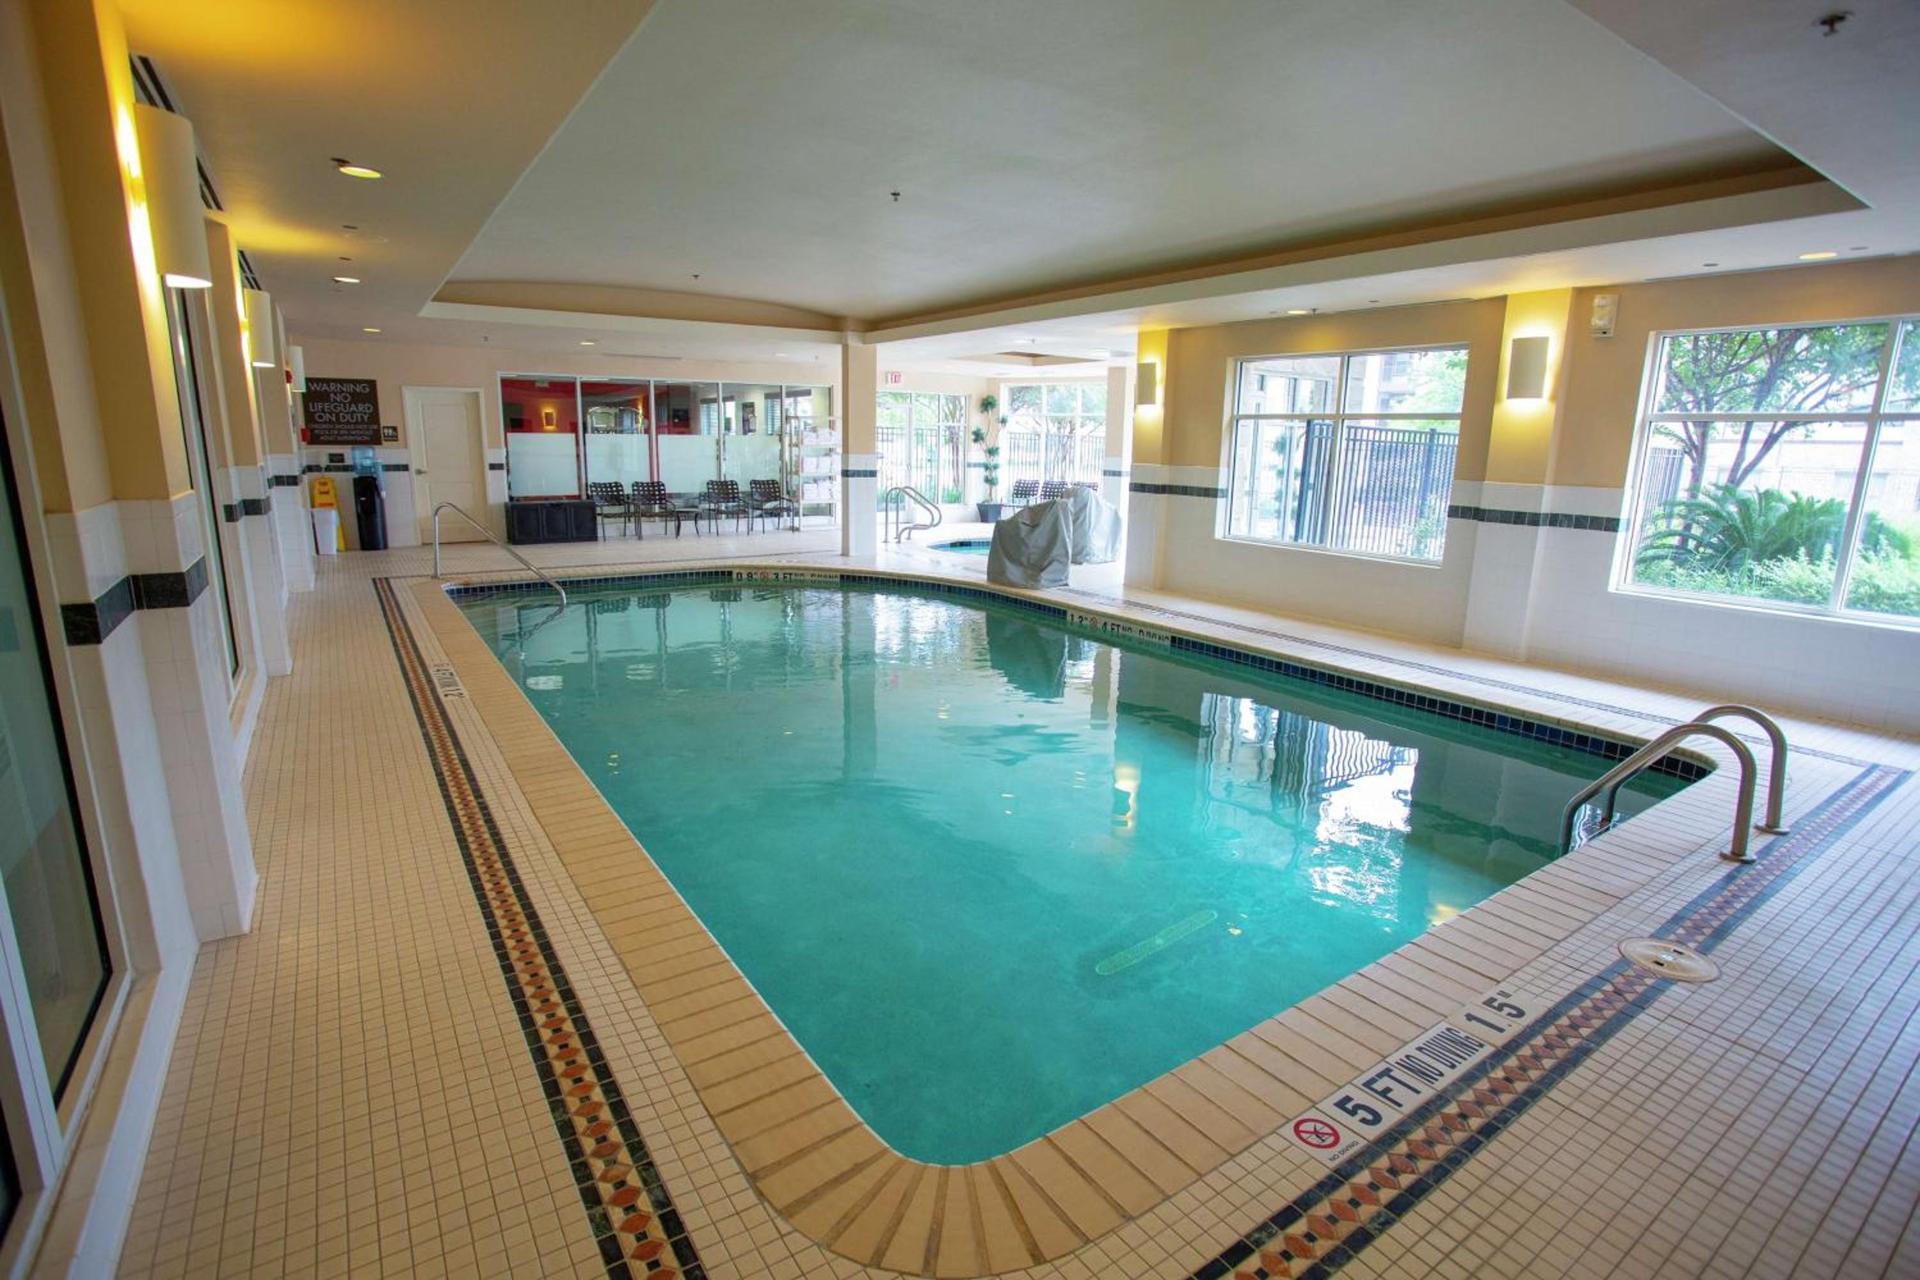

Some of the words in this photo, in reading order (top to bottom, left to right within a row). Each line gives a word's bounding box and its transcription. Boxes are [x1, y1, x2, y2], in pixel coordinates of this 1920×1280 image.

[308, 382, 370, 393] WARNING
[330, 393, 351, 402] NO
[309, 402, 374, 413] LIFEGUARD
[315, 412, 336, 422] ON
[340, 413, 369, 422] DUTY
[1415, 1027, 1485, 1070] DIVING
[1395, 1054, 1445, 1085] NO
[1361, 1066, 1422, 1108] FT
[1333, 1094, 1383, 1127] 5
